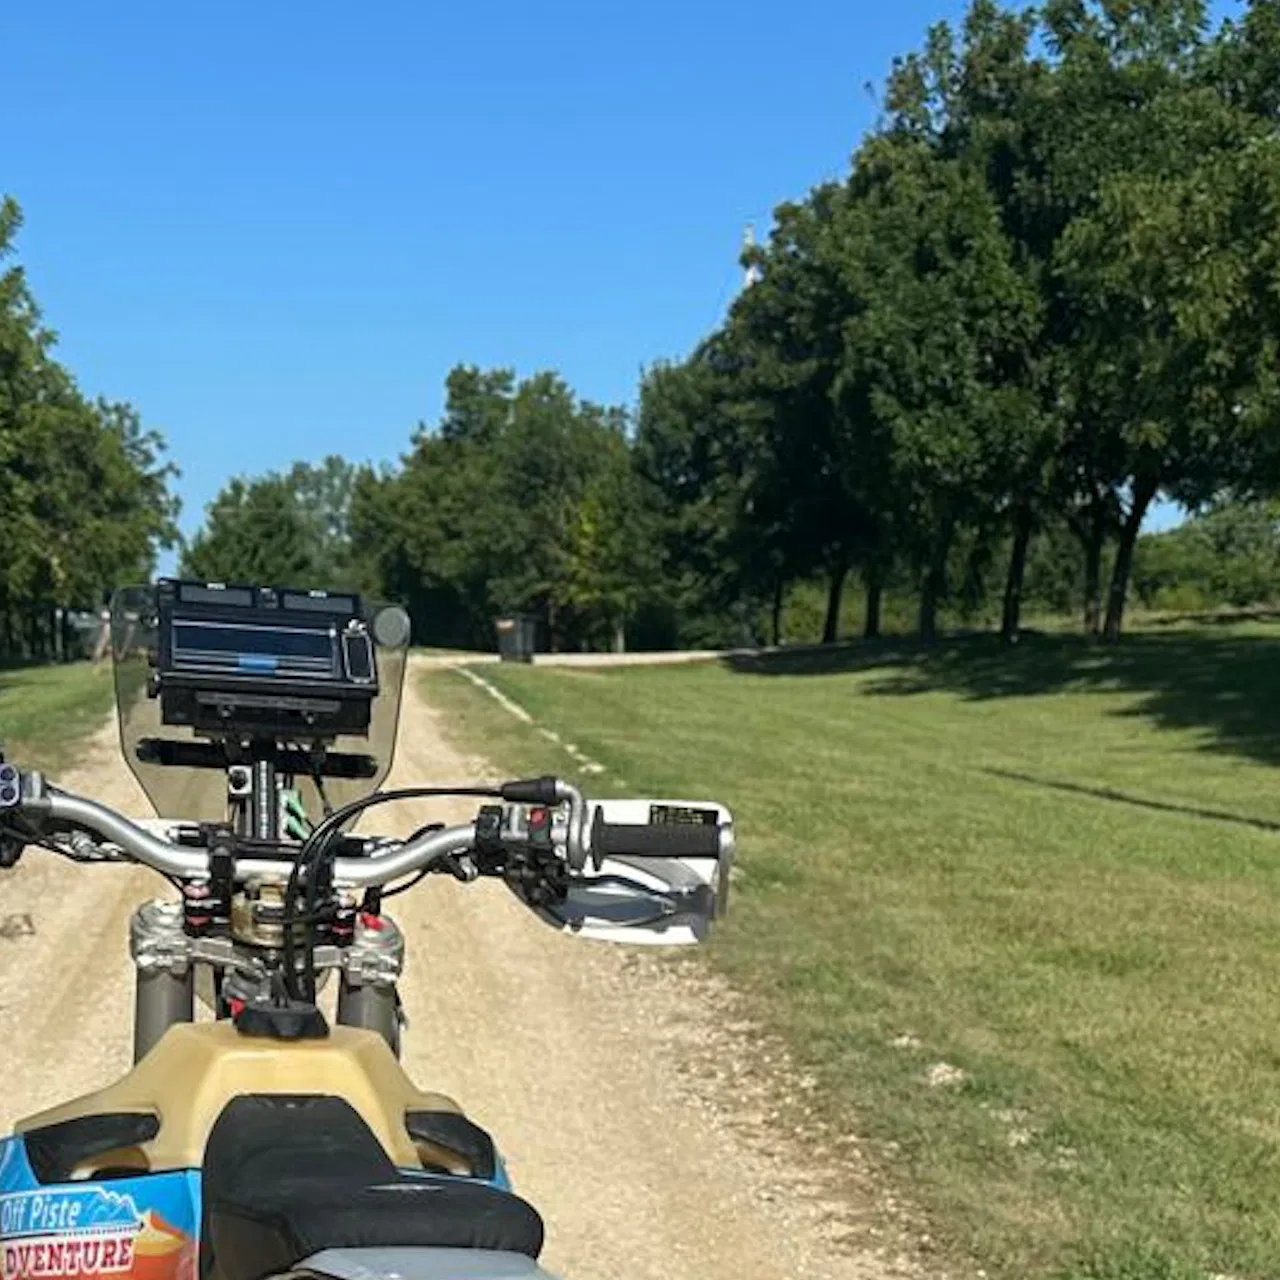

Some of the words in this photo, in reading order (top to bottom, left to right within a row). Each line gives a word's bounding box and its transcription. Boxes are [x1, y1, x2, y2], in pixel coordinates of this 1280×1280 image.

[1, 1199, 28, 1233] Off
[30, 1194, 81, 1230] Piste
[4, 1238, 133, 1275] DVENTURE
